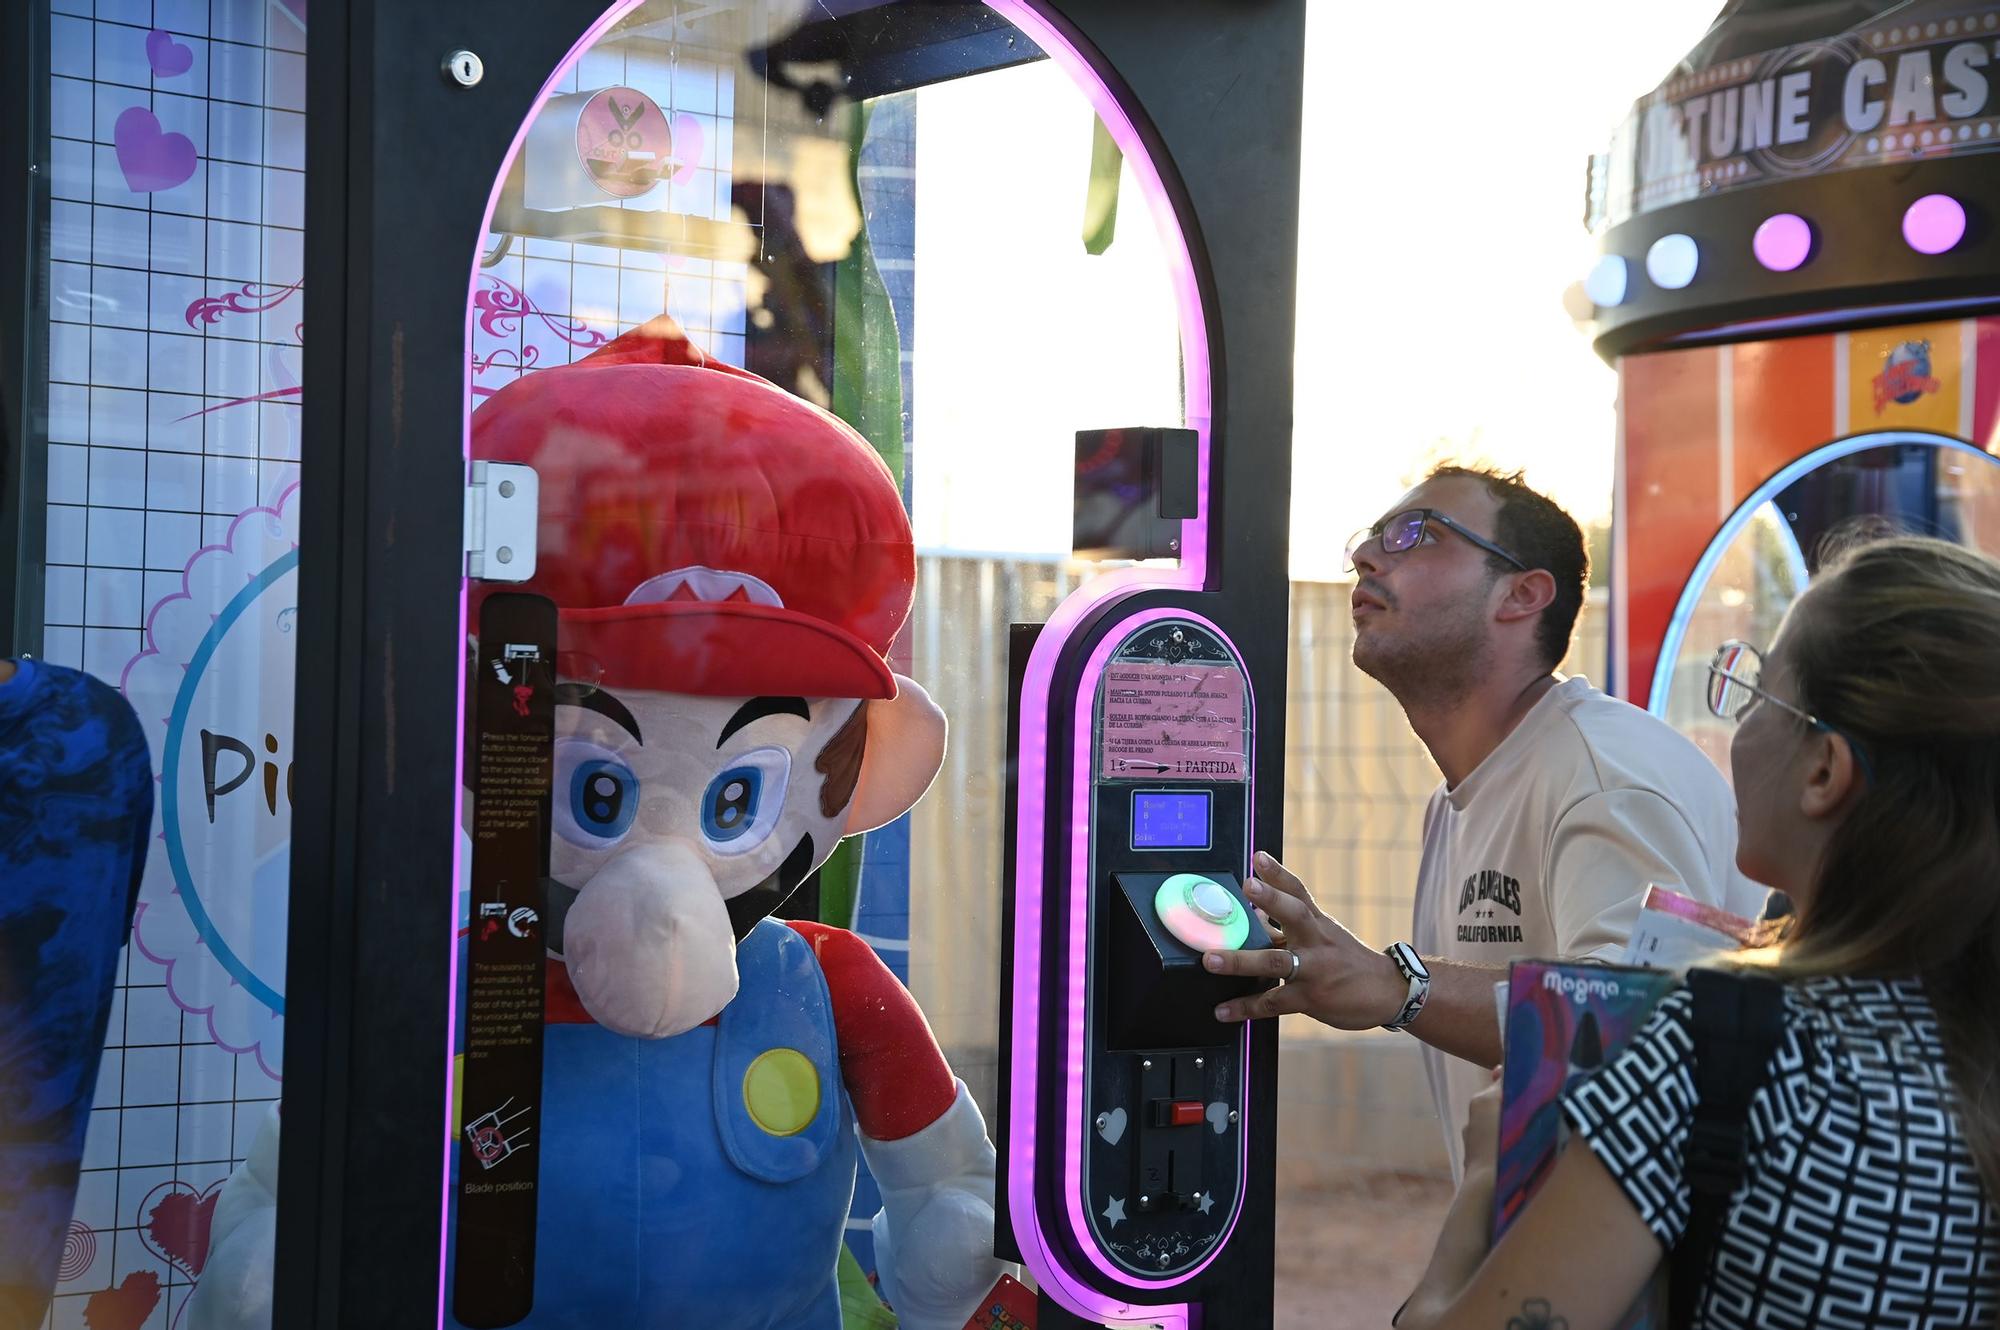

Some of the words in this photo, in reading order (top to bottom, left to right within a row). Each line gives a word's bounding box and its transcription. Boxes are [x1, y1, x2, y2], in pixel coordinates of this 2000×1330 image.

[1110, 759, 1116, 772] 1
[1119, 760, 1126, 772] €
[1176, 761, 1182, 773] 1
[1185, 760, 1237, 774] PARTIDA
[1458, 872, 1477, 915] LOS
[1457, 924, 1524, 943] CALIFORNIA
[465, 1182, 494, 1194] Blade
[495, 1181, 534, 1195] position
